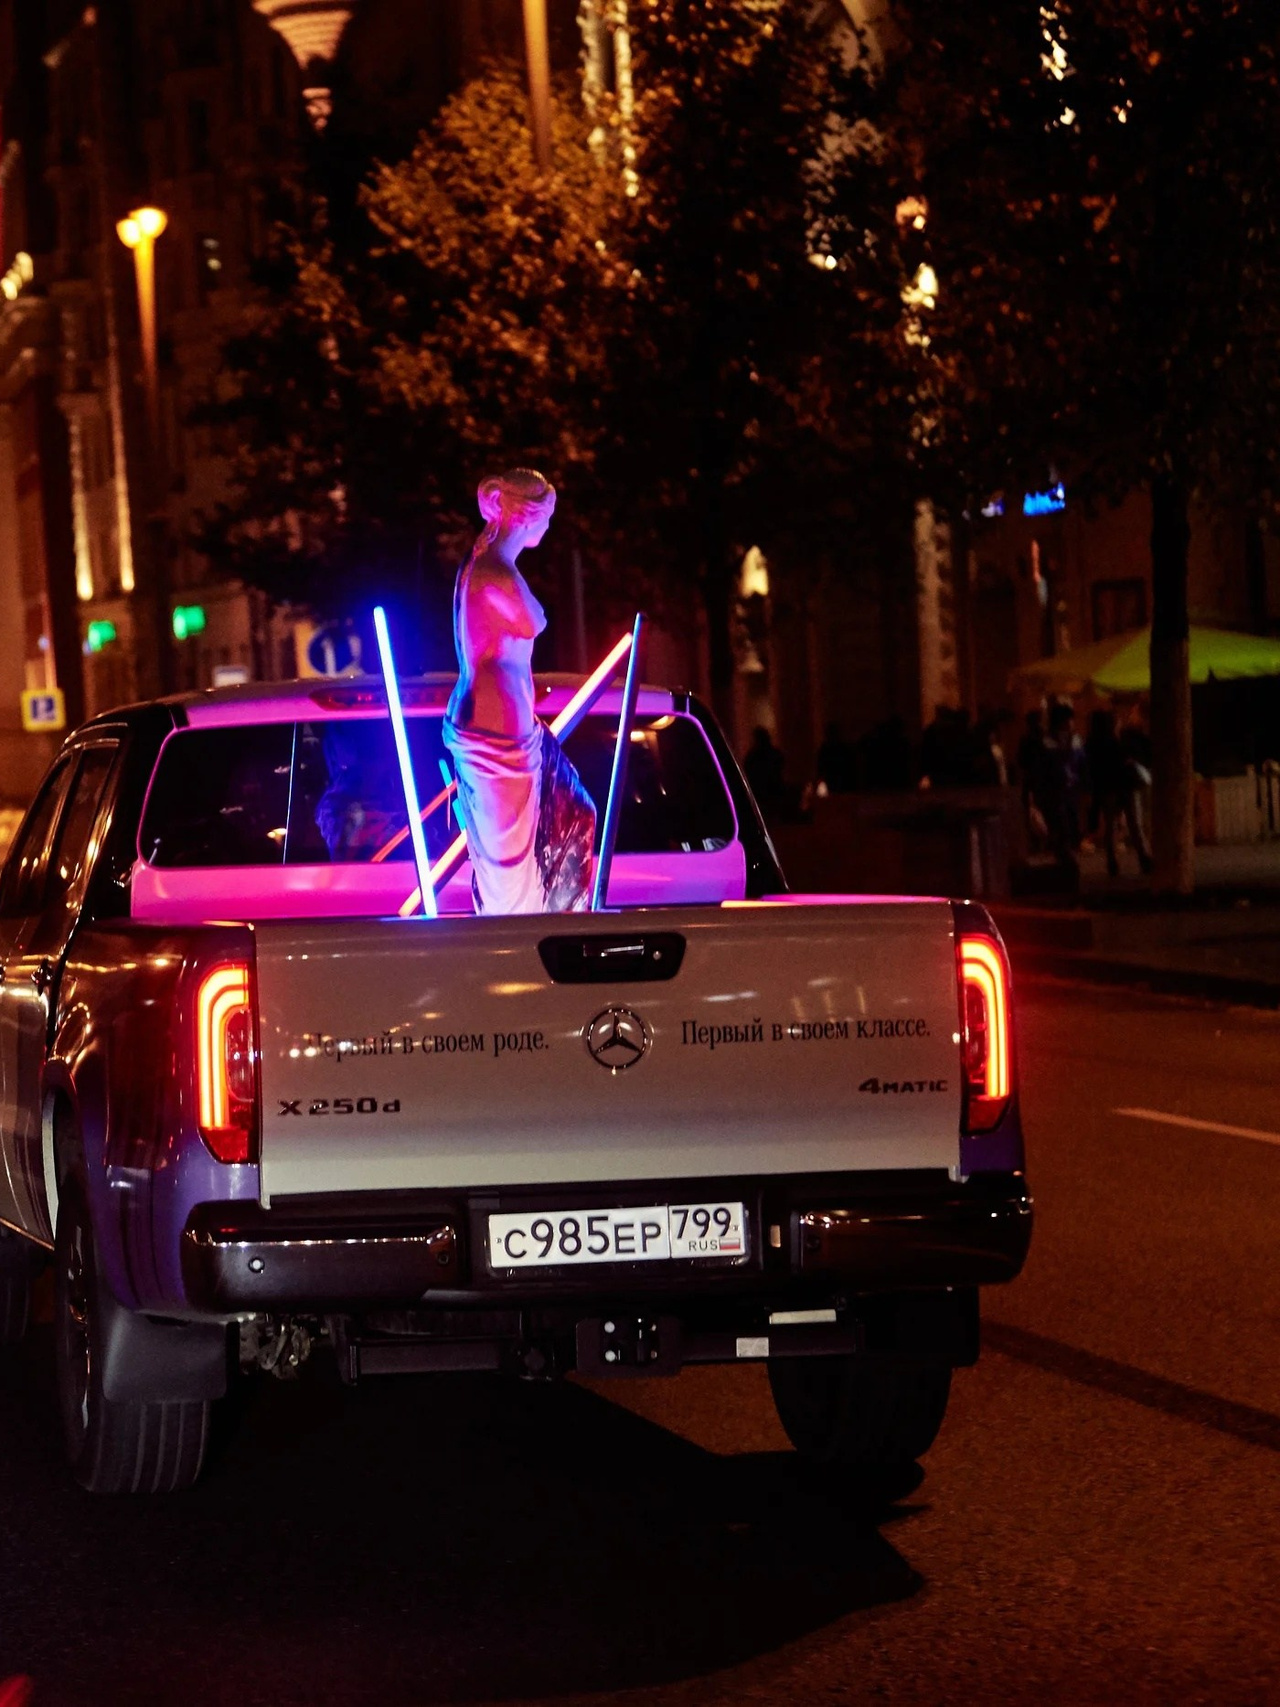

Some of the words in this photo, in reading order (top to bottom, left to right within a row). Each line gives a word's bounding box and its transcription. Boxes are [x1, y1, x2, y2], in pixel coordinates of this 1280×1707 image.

[402, 1035, 415, 1055] в
[421, 1033, 485, 1053] своем
[493, 1031, 550, 1057] роде.
[681, 1017, 764, 1050] Первый
[771, 1024, 783, 1042] в
[789, 1020, 849, 1041] своем
[856, 1017, 931, 1039] классе.
[671, 1207, 732, 1240] 799
[688, 1239, 719, 1252] RUS
